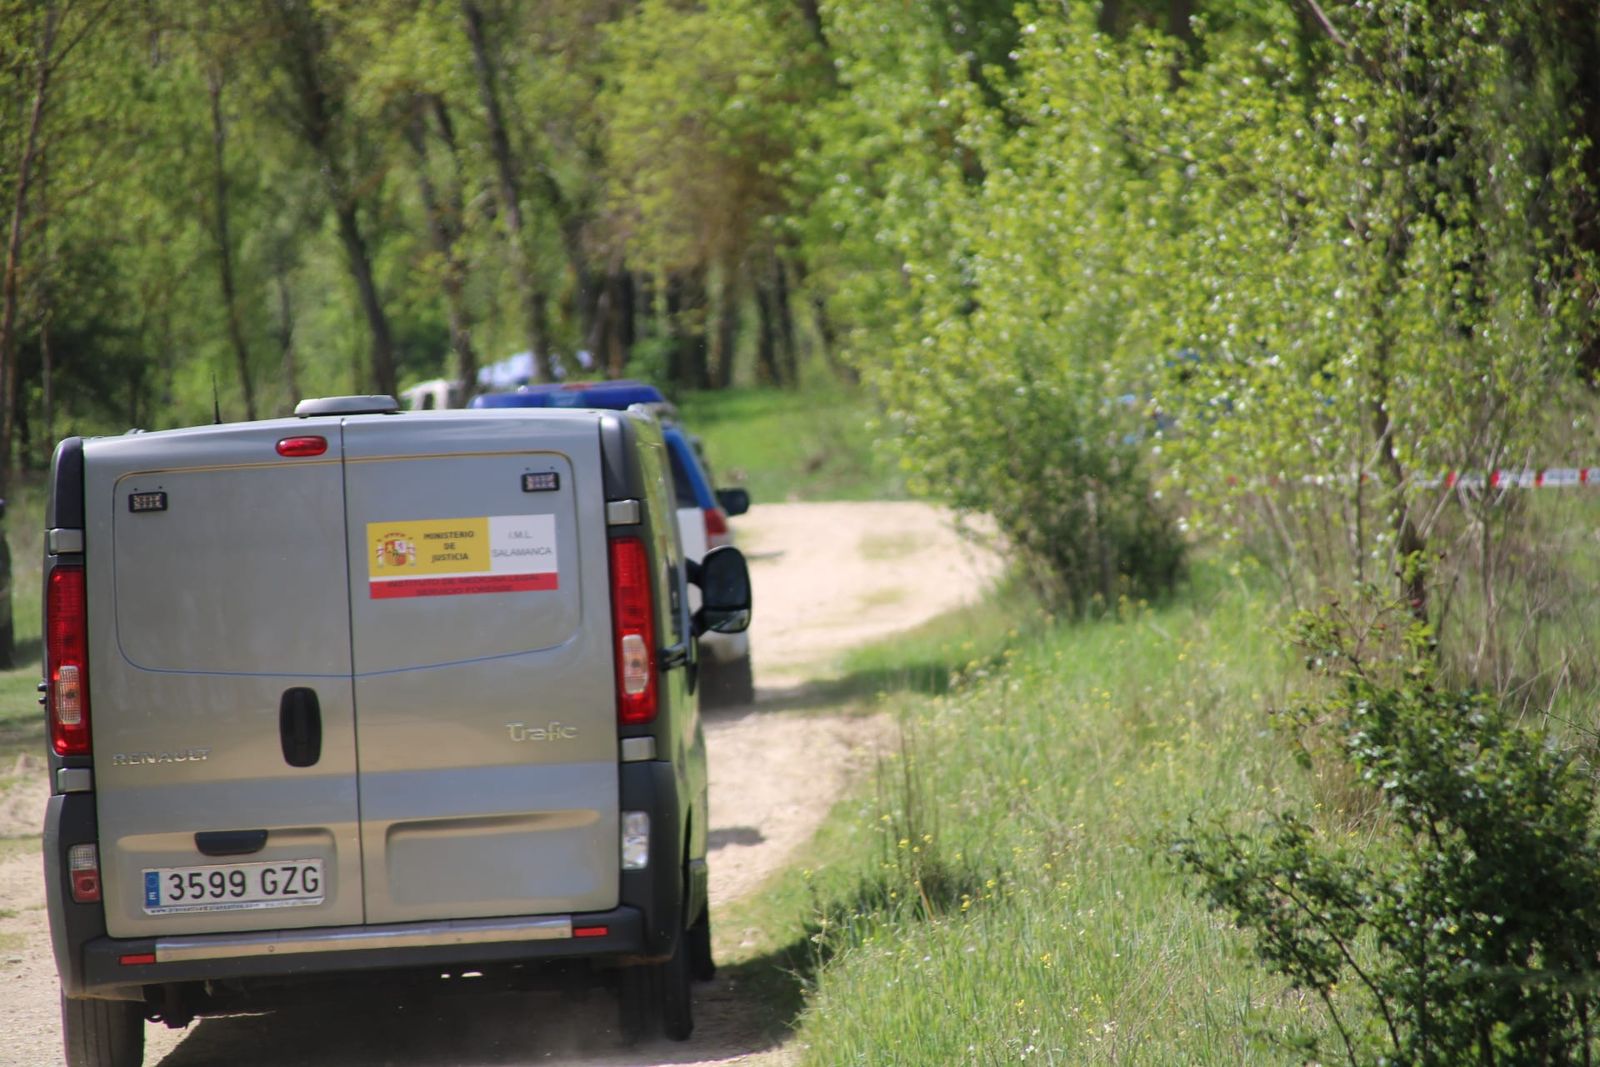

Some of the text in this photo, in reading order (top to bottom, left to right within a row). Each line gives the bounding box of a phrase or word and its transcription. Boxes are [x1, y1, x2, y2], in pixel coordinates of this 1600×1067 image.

[423, 530, 475, 540] MINISTERIO
[443, 542, 456, 551] DE
[492, 546, 552, 558] SALAMANCA
[431, 553, 469, 563] JUSTICIA
[503, 720, 578, 742] Trafic
[112, 747, 211, 766] RENAULT
[168, 865, 320, 902] 3599 GZG
